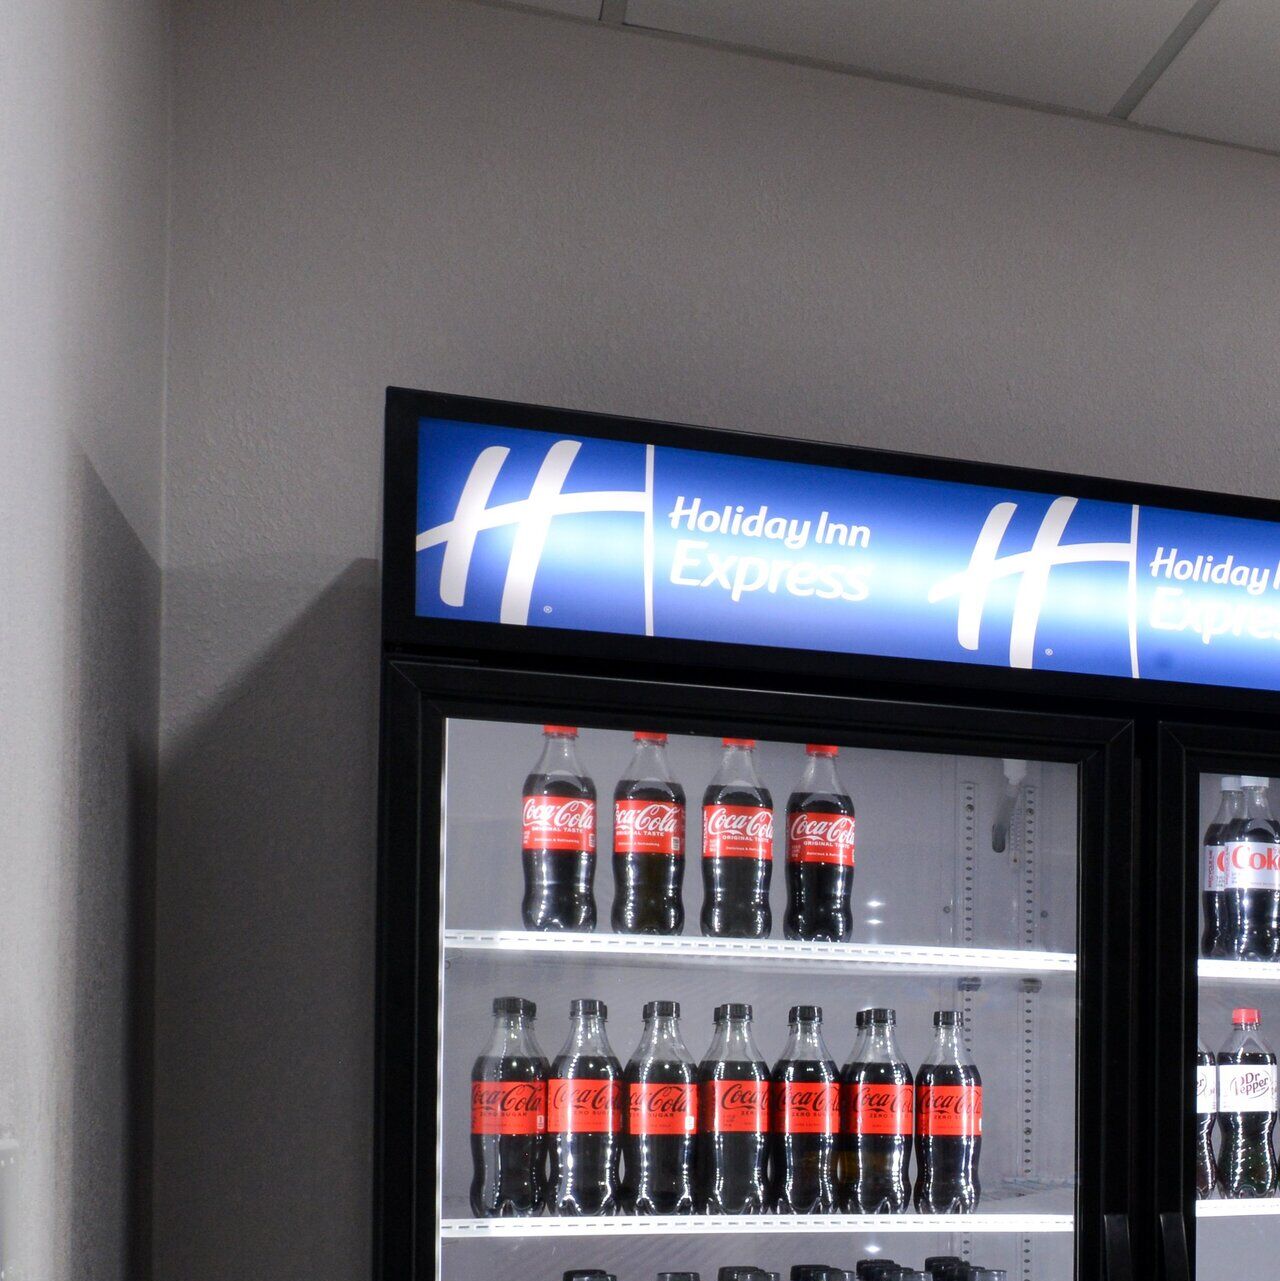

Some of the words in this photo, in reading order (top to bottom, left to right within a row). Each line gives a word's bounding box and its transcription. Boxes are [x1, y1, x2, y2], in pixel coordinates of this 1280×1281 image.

[669, 496, 811, 549] Holiday
[816, 511, 870, 548] Inn
[670, 540, 870, 602] Express
[1150, 547, 1271, 594] Holiday
[523, 799, 595, 829] Coca-Cola
[616, 804, 679, 832] oca-Cola
[1246, 1072, 1260, 1082] Dr
